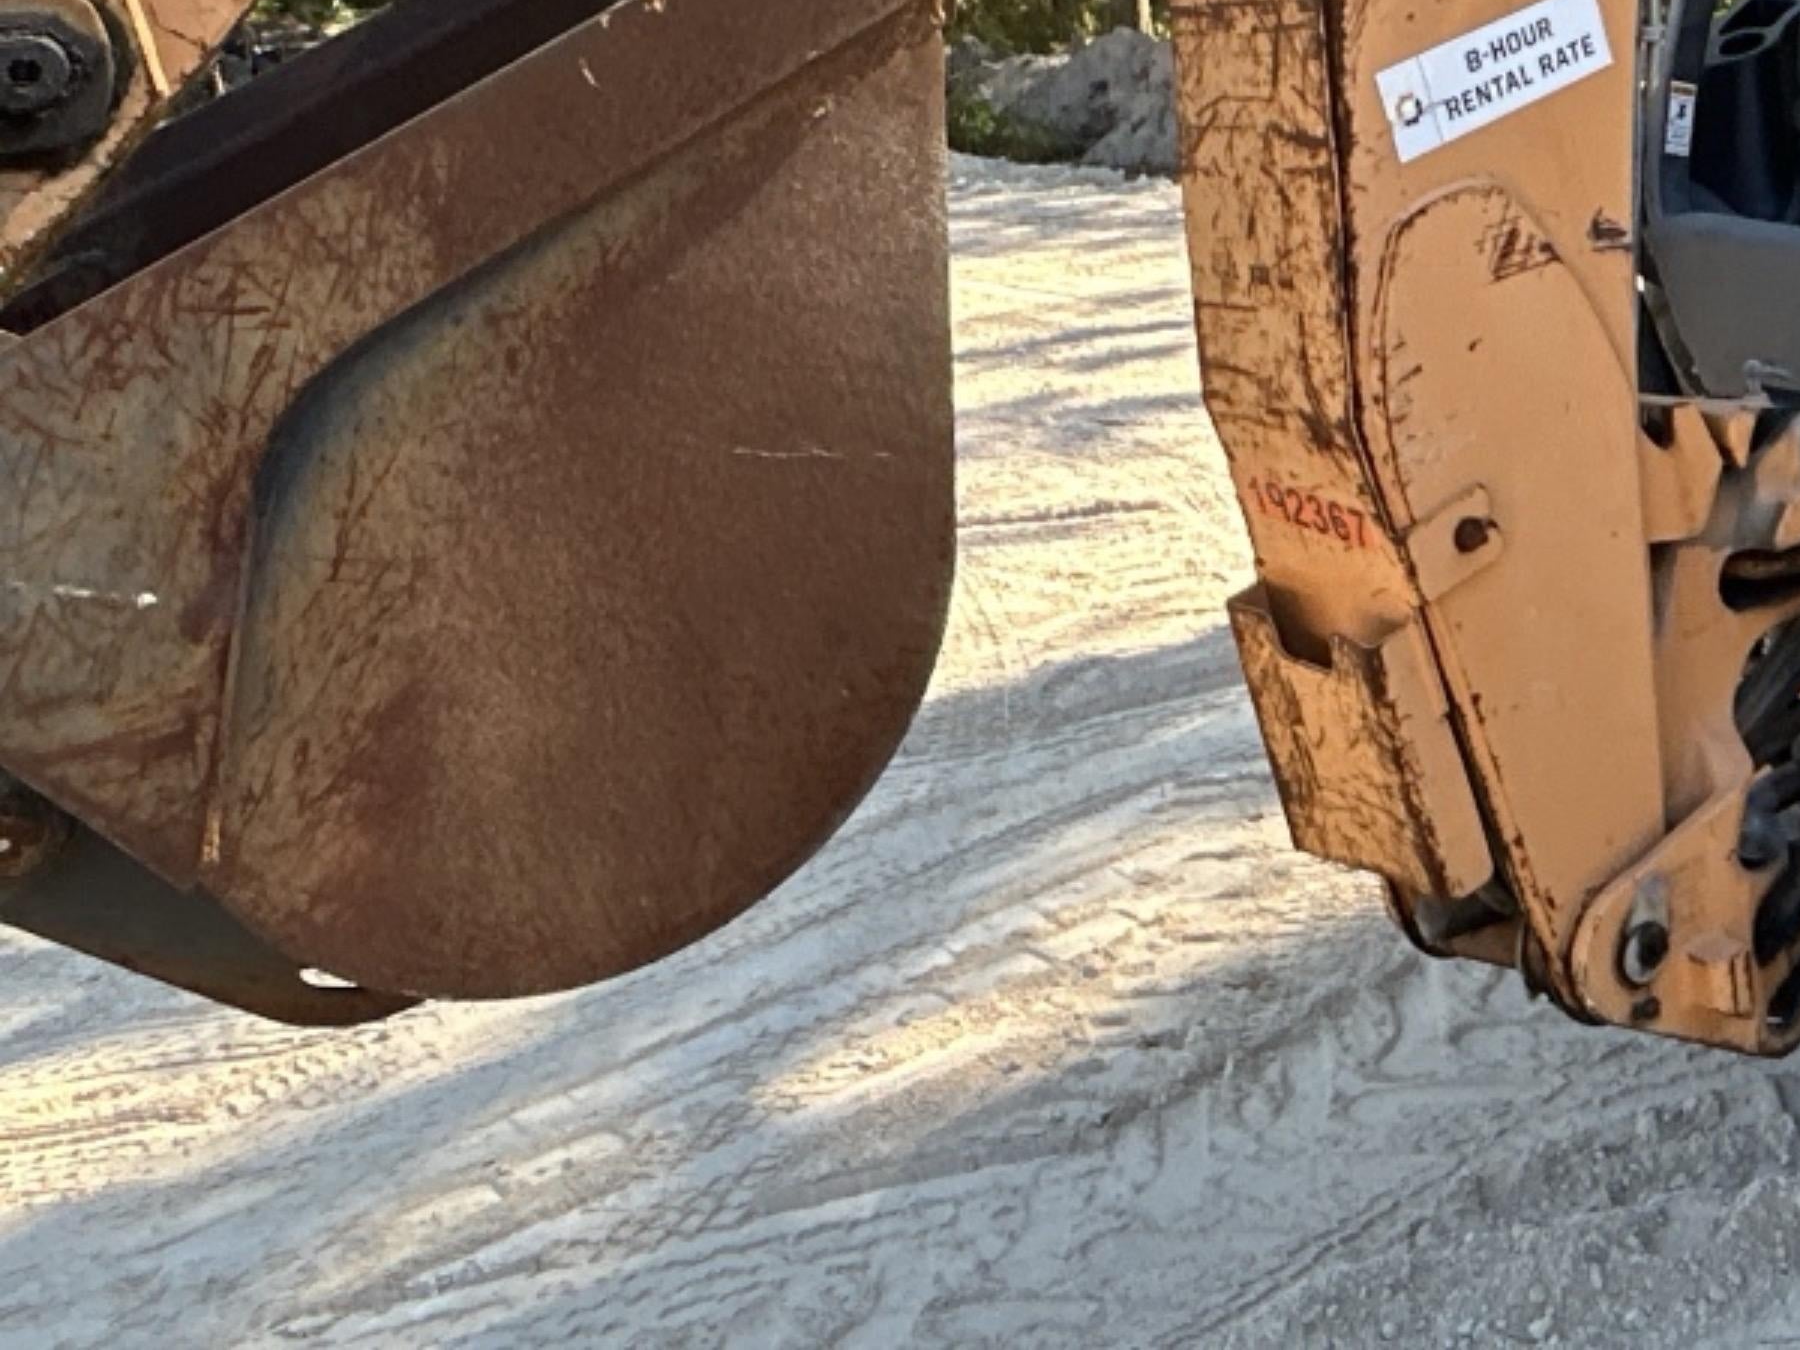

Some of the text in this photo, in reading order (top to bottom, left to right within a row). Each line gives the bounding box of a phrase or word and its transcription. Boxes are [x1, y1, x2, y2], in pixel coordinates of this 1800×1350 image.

[1445, 34, 1596, 120] RENTAL RATE
[1249, 477, 1365, 547] 192367
